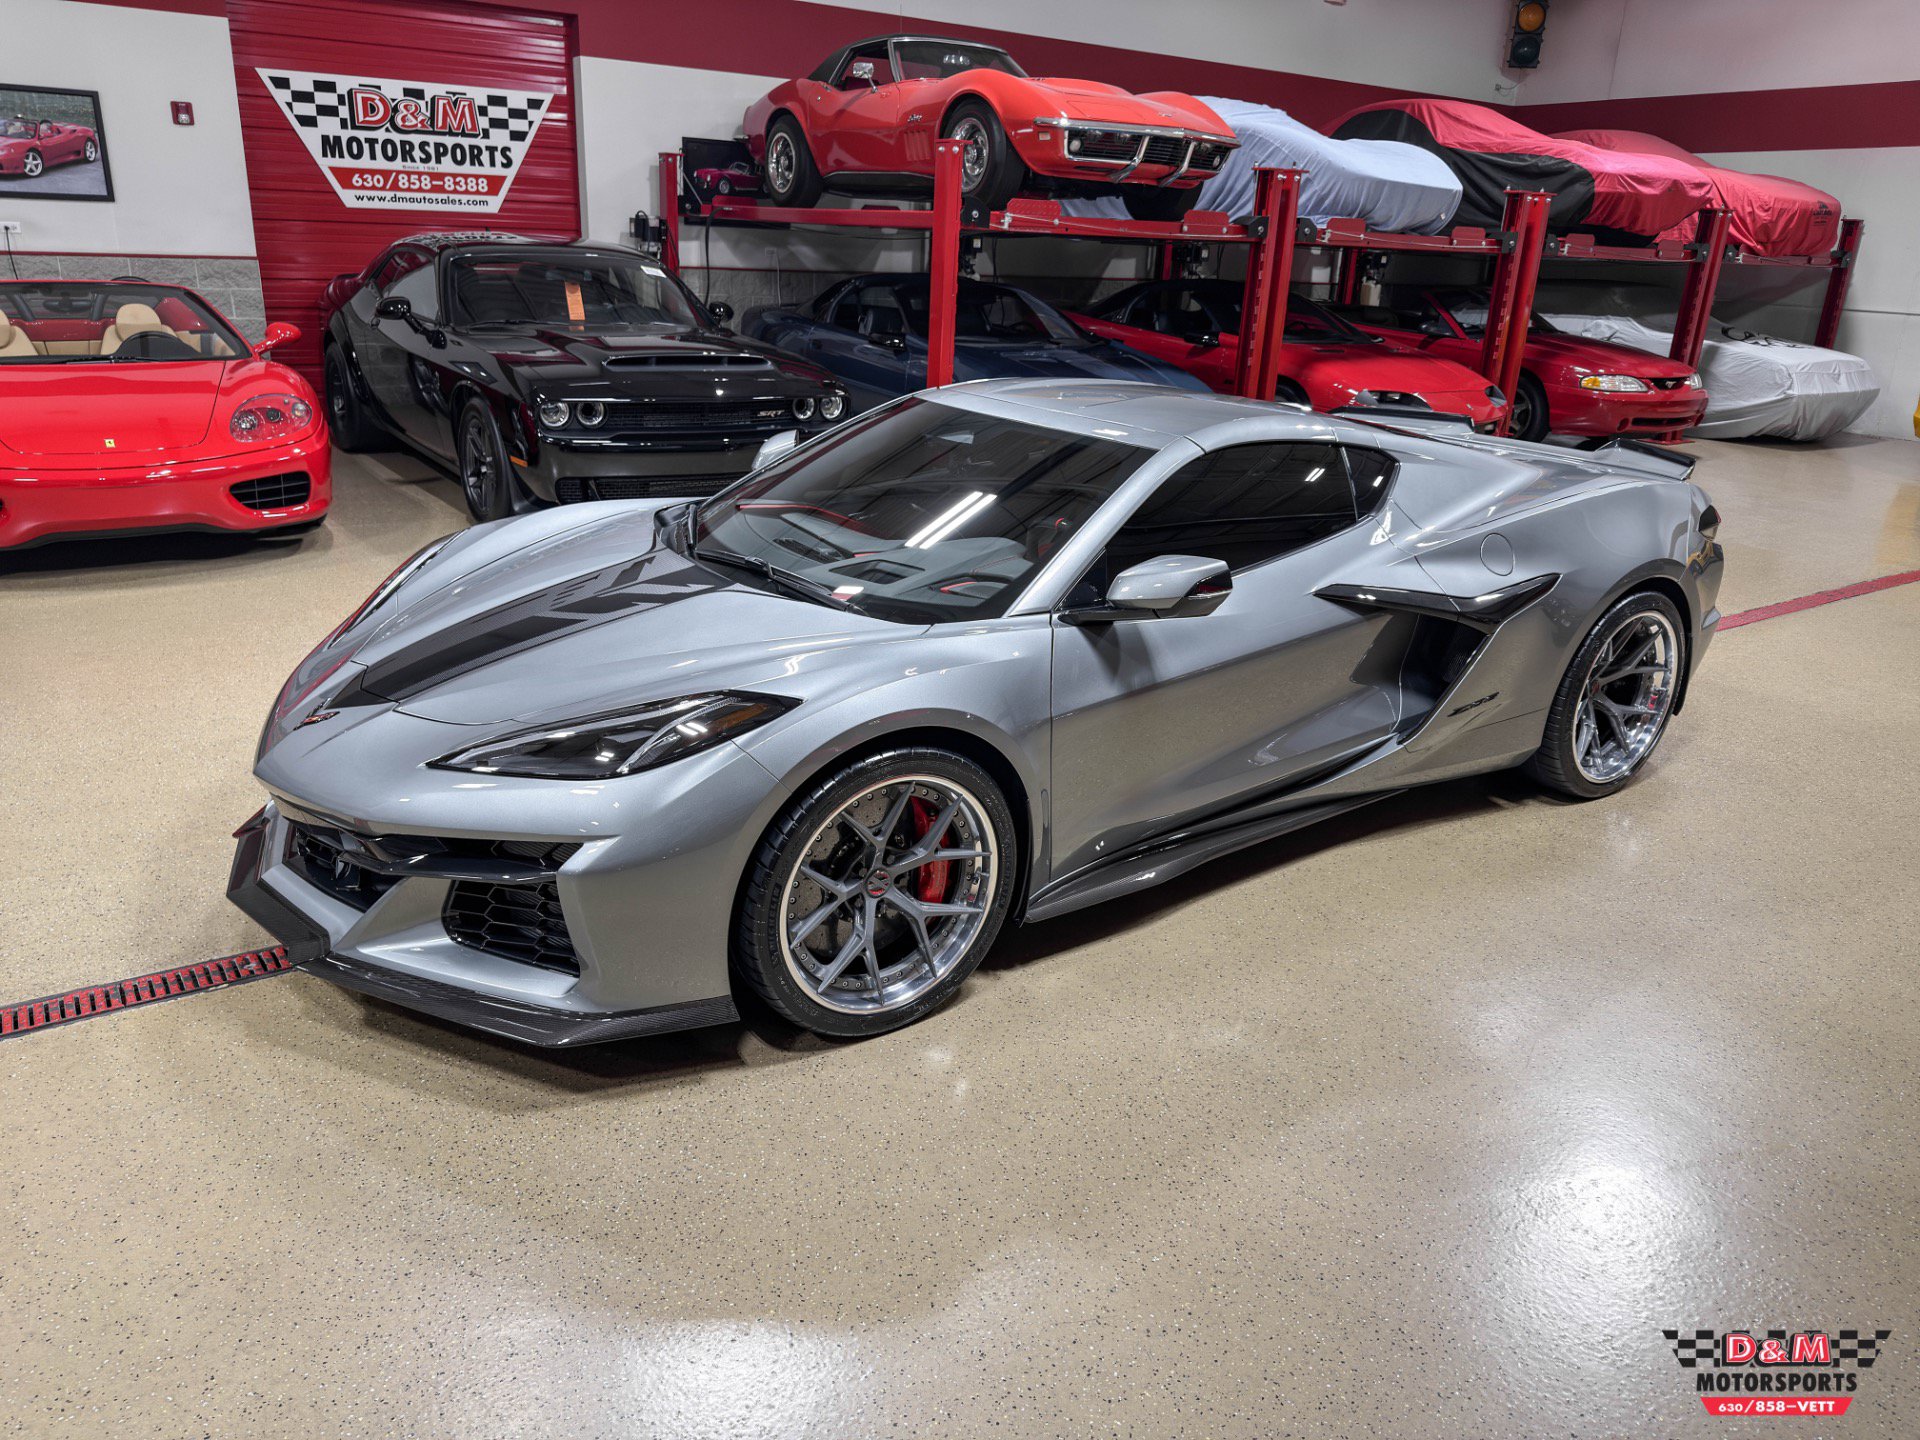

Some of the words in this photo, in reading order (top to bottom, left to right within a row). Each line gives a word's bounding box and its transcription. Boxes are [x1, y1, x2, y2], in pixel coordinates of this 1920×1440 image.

[347, 88, 482, 137] D&M
[321, 134, 514, 169] MOTORSPORTS
[354, 193, 489, 207] www.dmautosales.com
